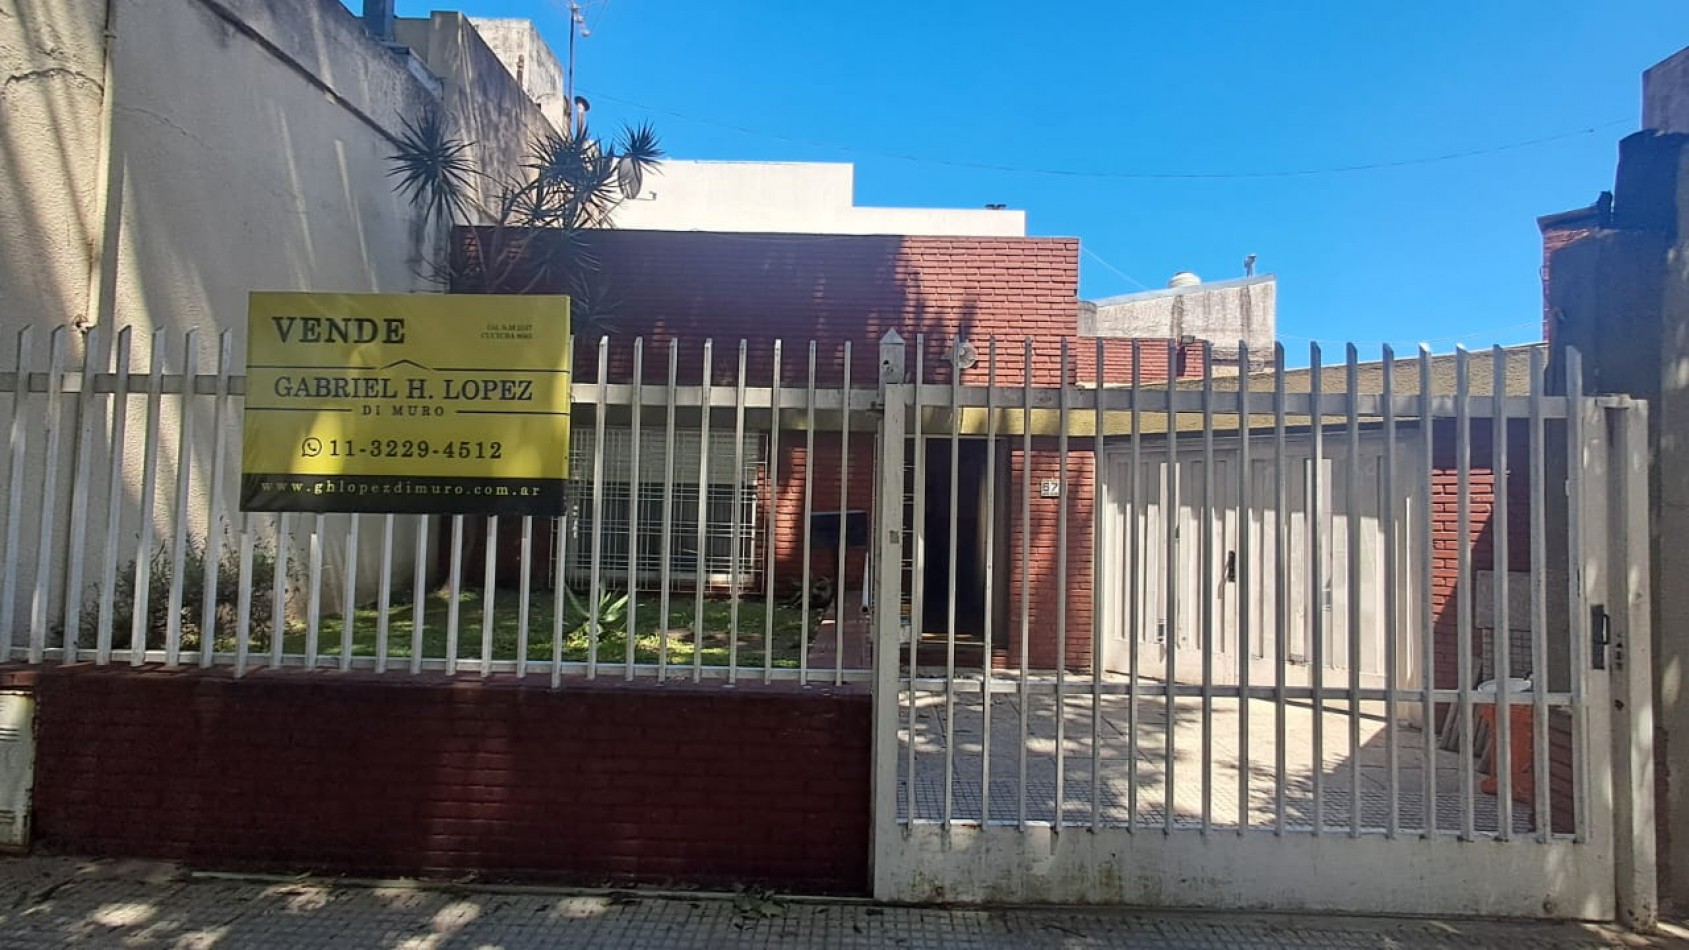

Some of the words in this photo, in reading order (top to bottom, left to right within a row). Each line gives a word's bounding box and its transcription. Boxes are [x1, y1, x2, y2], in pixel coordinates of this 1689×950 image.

[271, 316, 405, 344] VENDE
[274, 376, 398, 398] GABRIEL
[406, 379, 433, 399] H.
[443, 379, 533, 401] LOPEZ
[362, 405, 381, 415] DI
[392, 405, 444, 417] MURO
[330, 440, 502, 459] 11-3229-4512
[261, 479, 541, 496] www.ghlopezdimuro.com.ar
